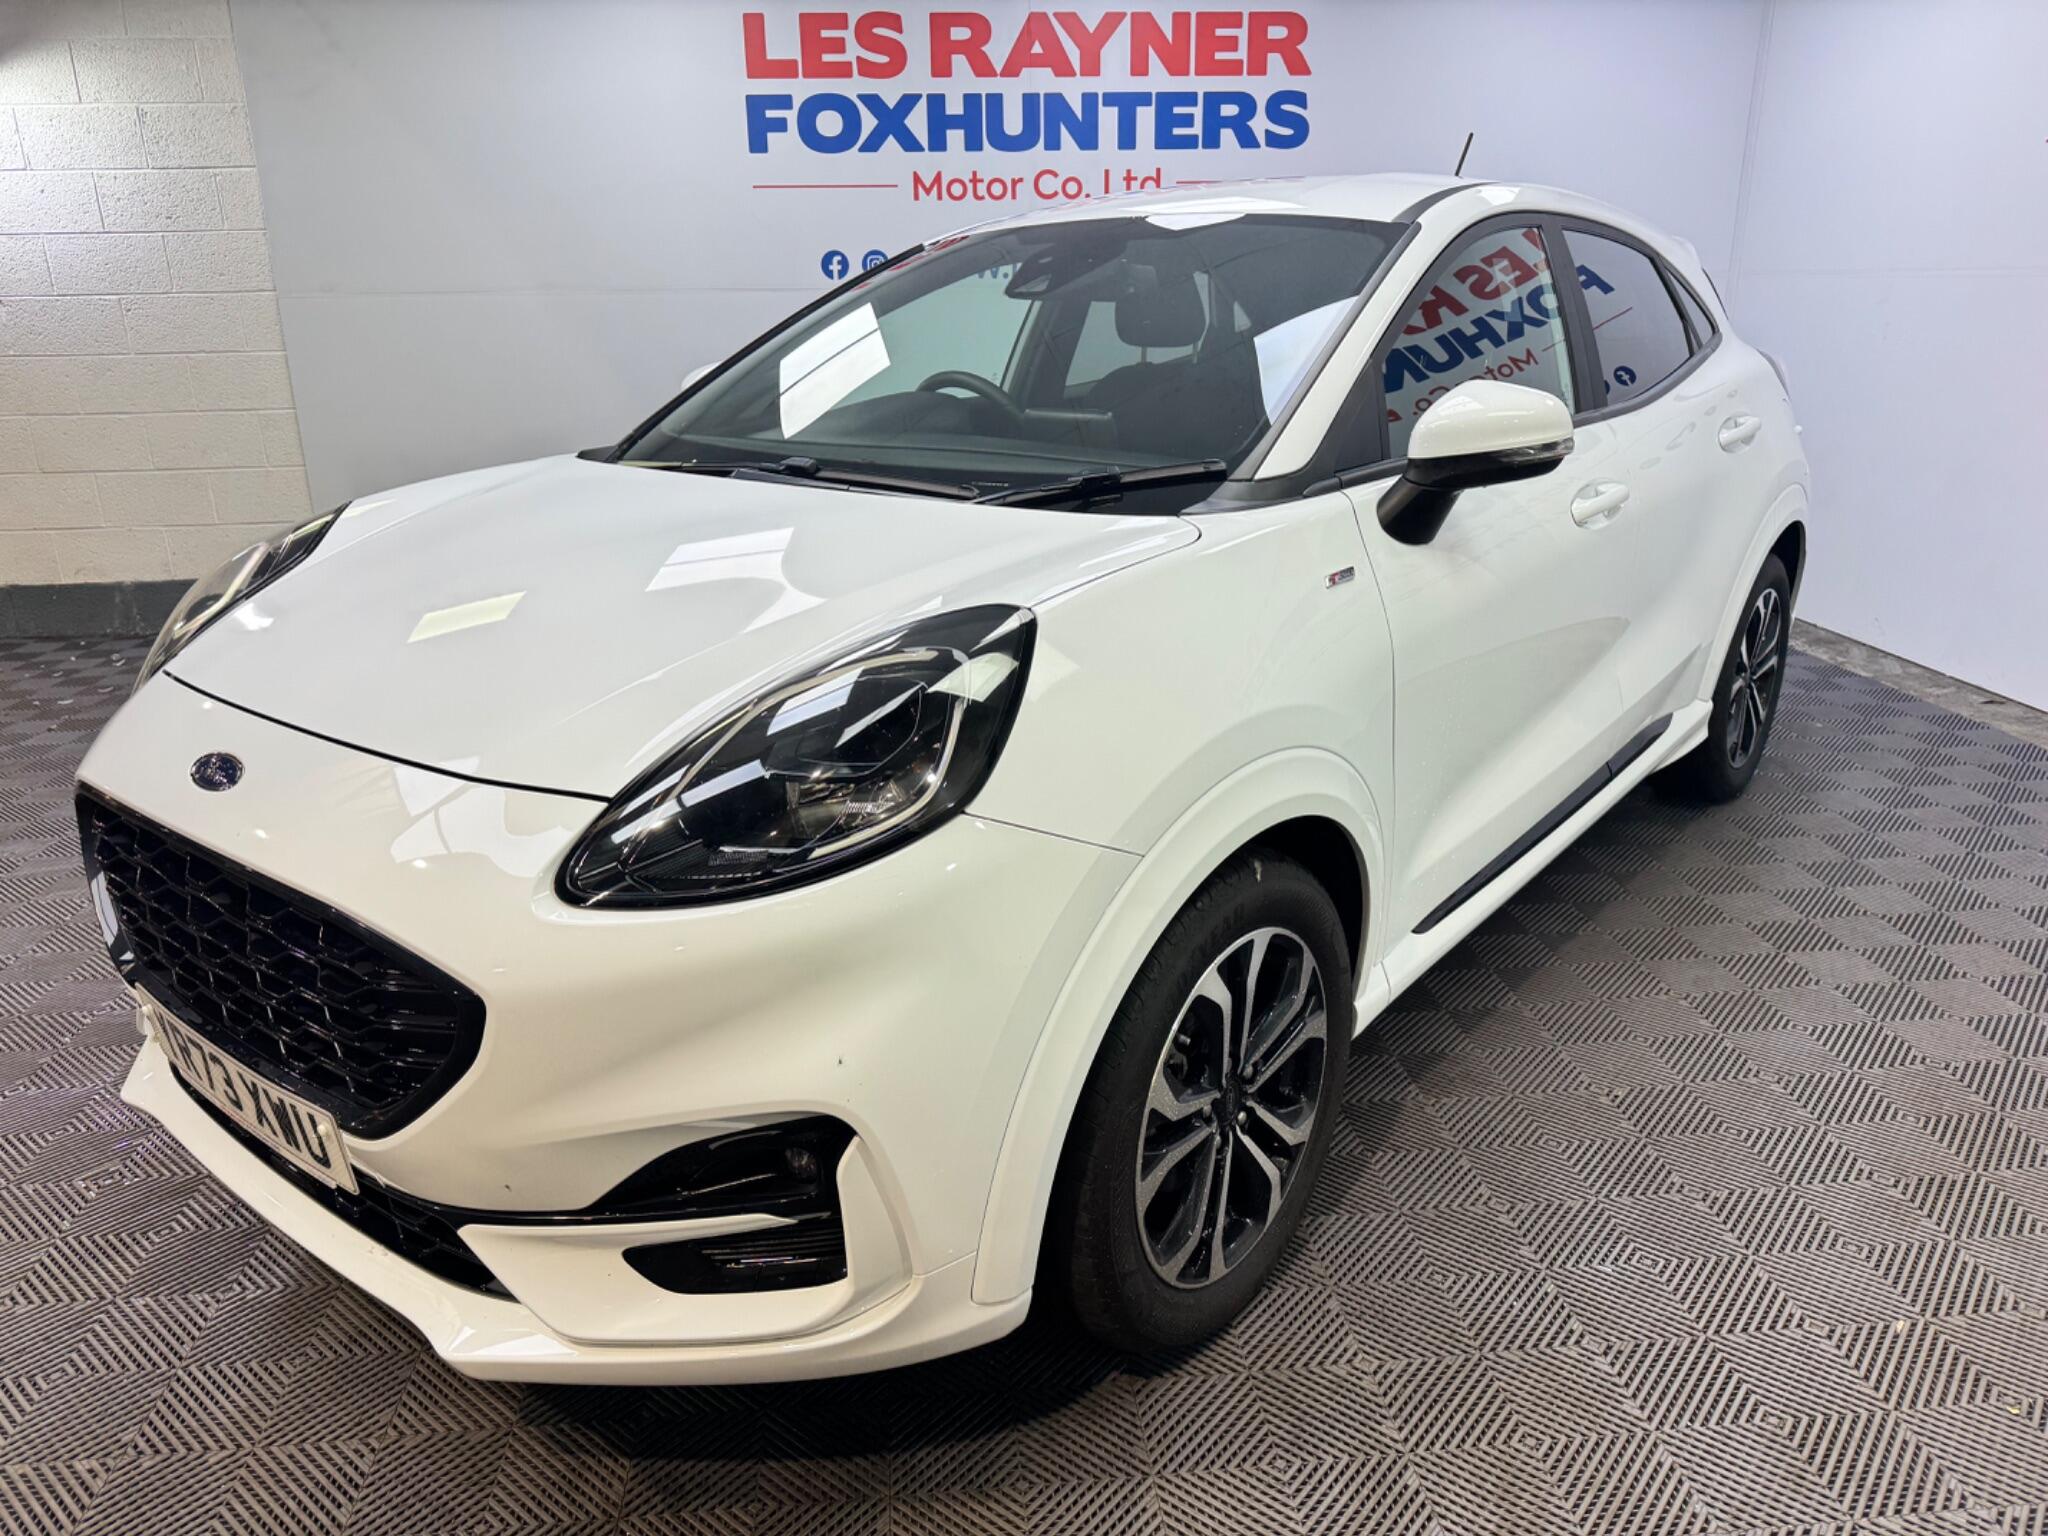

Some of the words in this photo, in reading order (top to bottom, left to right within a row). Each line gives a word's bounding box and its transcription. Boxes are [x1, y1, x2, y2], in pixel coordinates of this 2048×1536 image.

[743, 11, 908, 79] LES
[929, 11, 1312, 79] RAYNER
[745, 90, 1310, 154] FOXHUNTERS
[913, 171, 1025, 201] Motor
[1034, 169, 1090, 200] Co.
[1103, 168, 1162, 195] Ltd
[237, 1071, 331, 1169] XWU
